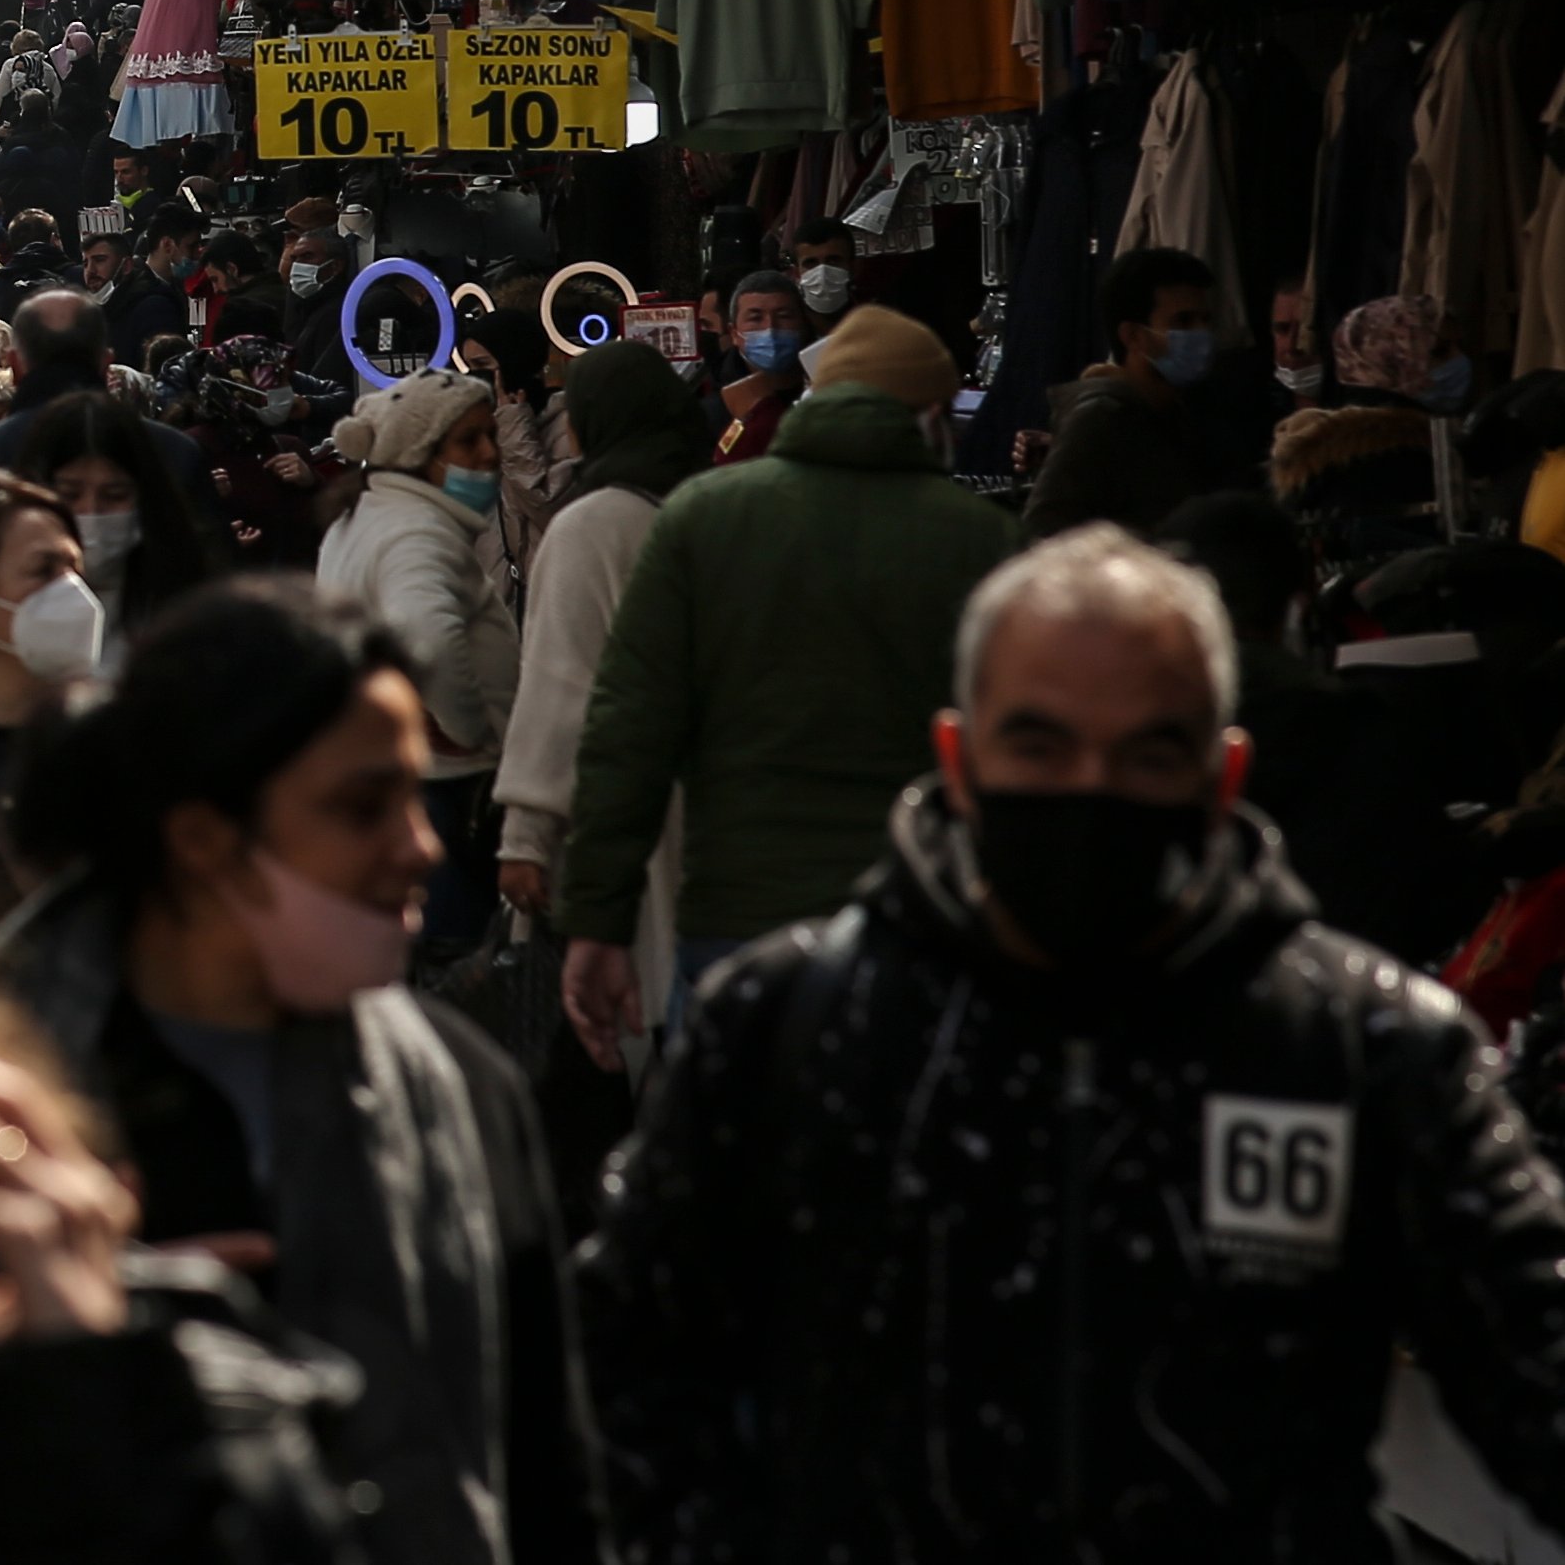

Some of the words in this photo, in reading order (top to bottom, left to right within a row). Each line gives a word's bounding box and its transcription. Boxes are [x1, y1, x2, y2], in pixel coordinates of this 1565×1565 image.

[258, 38, 310, 64] YENİ
[317, 40, 369, 63] YILA
[376, 36, 434, 62] ÖZEL
[466, 35, 540, 56] SEZON
[549, 36, 611, 57] SONU
[287, 69, 407, 93] KAPAKLAR
[479, 64, 598, 86] KAPAKLAR
[281, 97, 368, 156] 10
[373, 132, 415, 153] TL
[471, 90, 558, 149] 10
[564, 127, 605, 148] TL
[1226, 1119, 1332, 1220] 66
